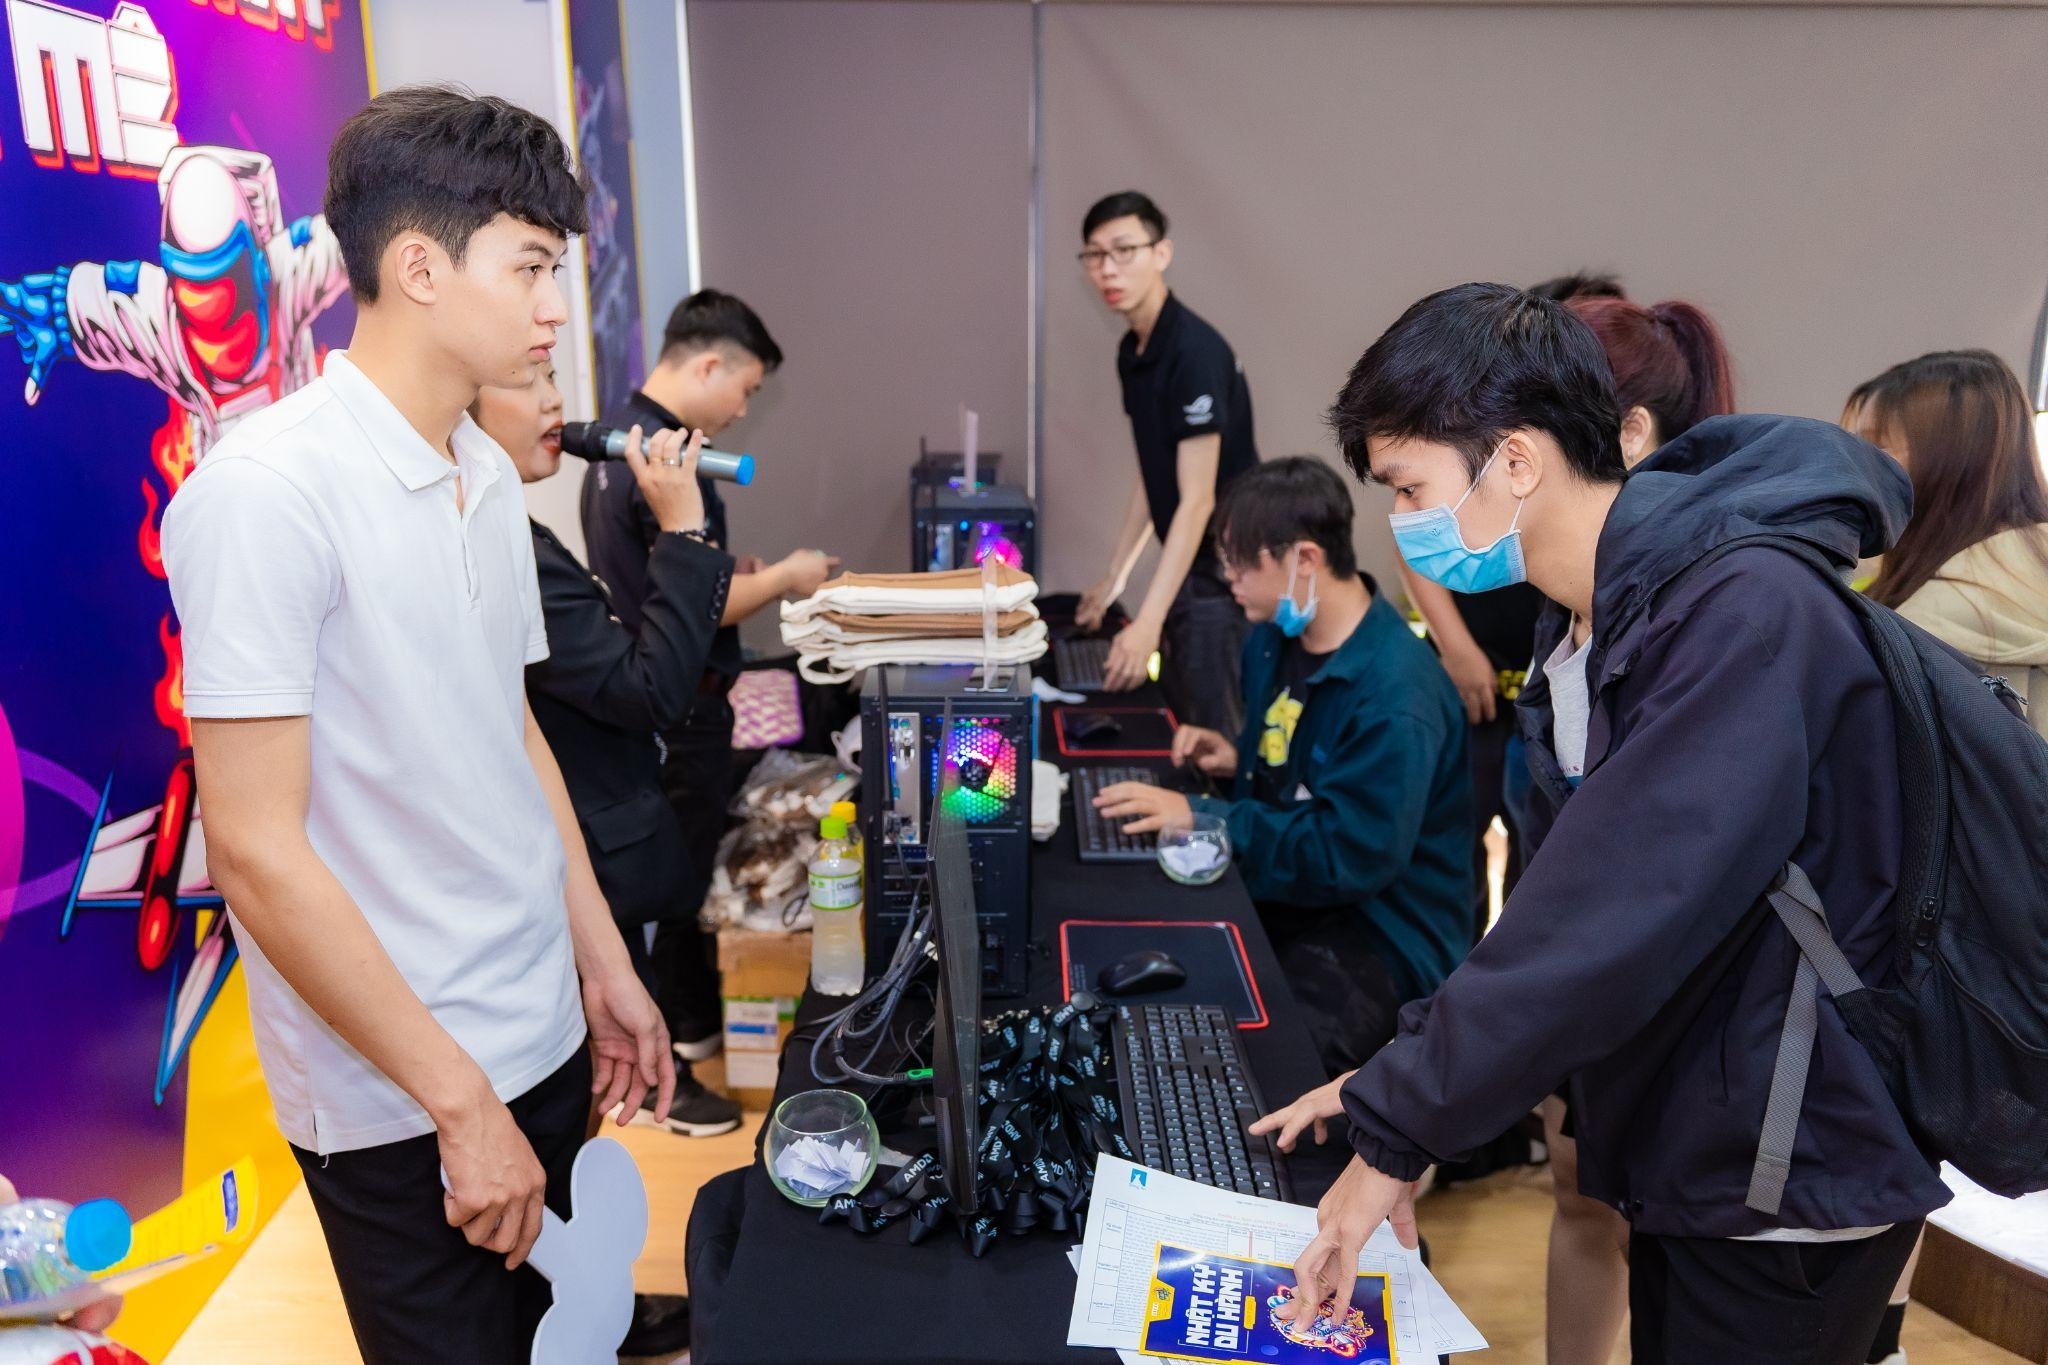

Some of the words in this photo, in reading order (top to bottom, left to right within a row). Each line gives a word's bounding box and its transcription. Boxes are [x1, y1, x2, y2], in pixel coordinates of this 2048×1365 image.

[1054, 1004, 1075, 1027] AMD
[1002, 1120, 1021, 1141] AMD
[989, 1136, 1003, 1162] AMD
[903, 1156, 931, 1183] AMD
[1034, 1157, 1051, 1183] AMD
[1190, 1263, 1217, 1294] KÝ
[1214, 1267, 1244, 1322] HÀNH
[1185, 1294, 1215, 1346] NHẬT
[1213, 1322, 1239, 1350] DU
